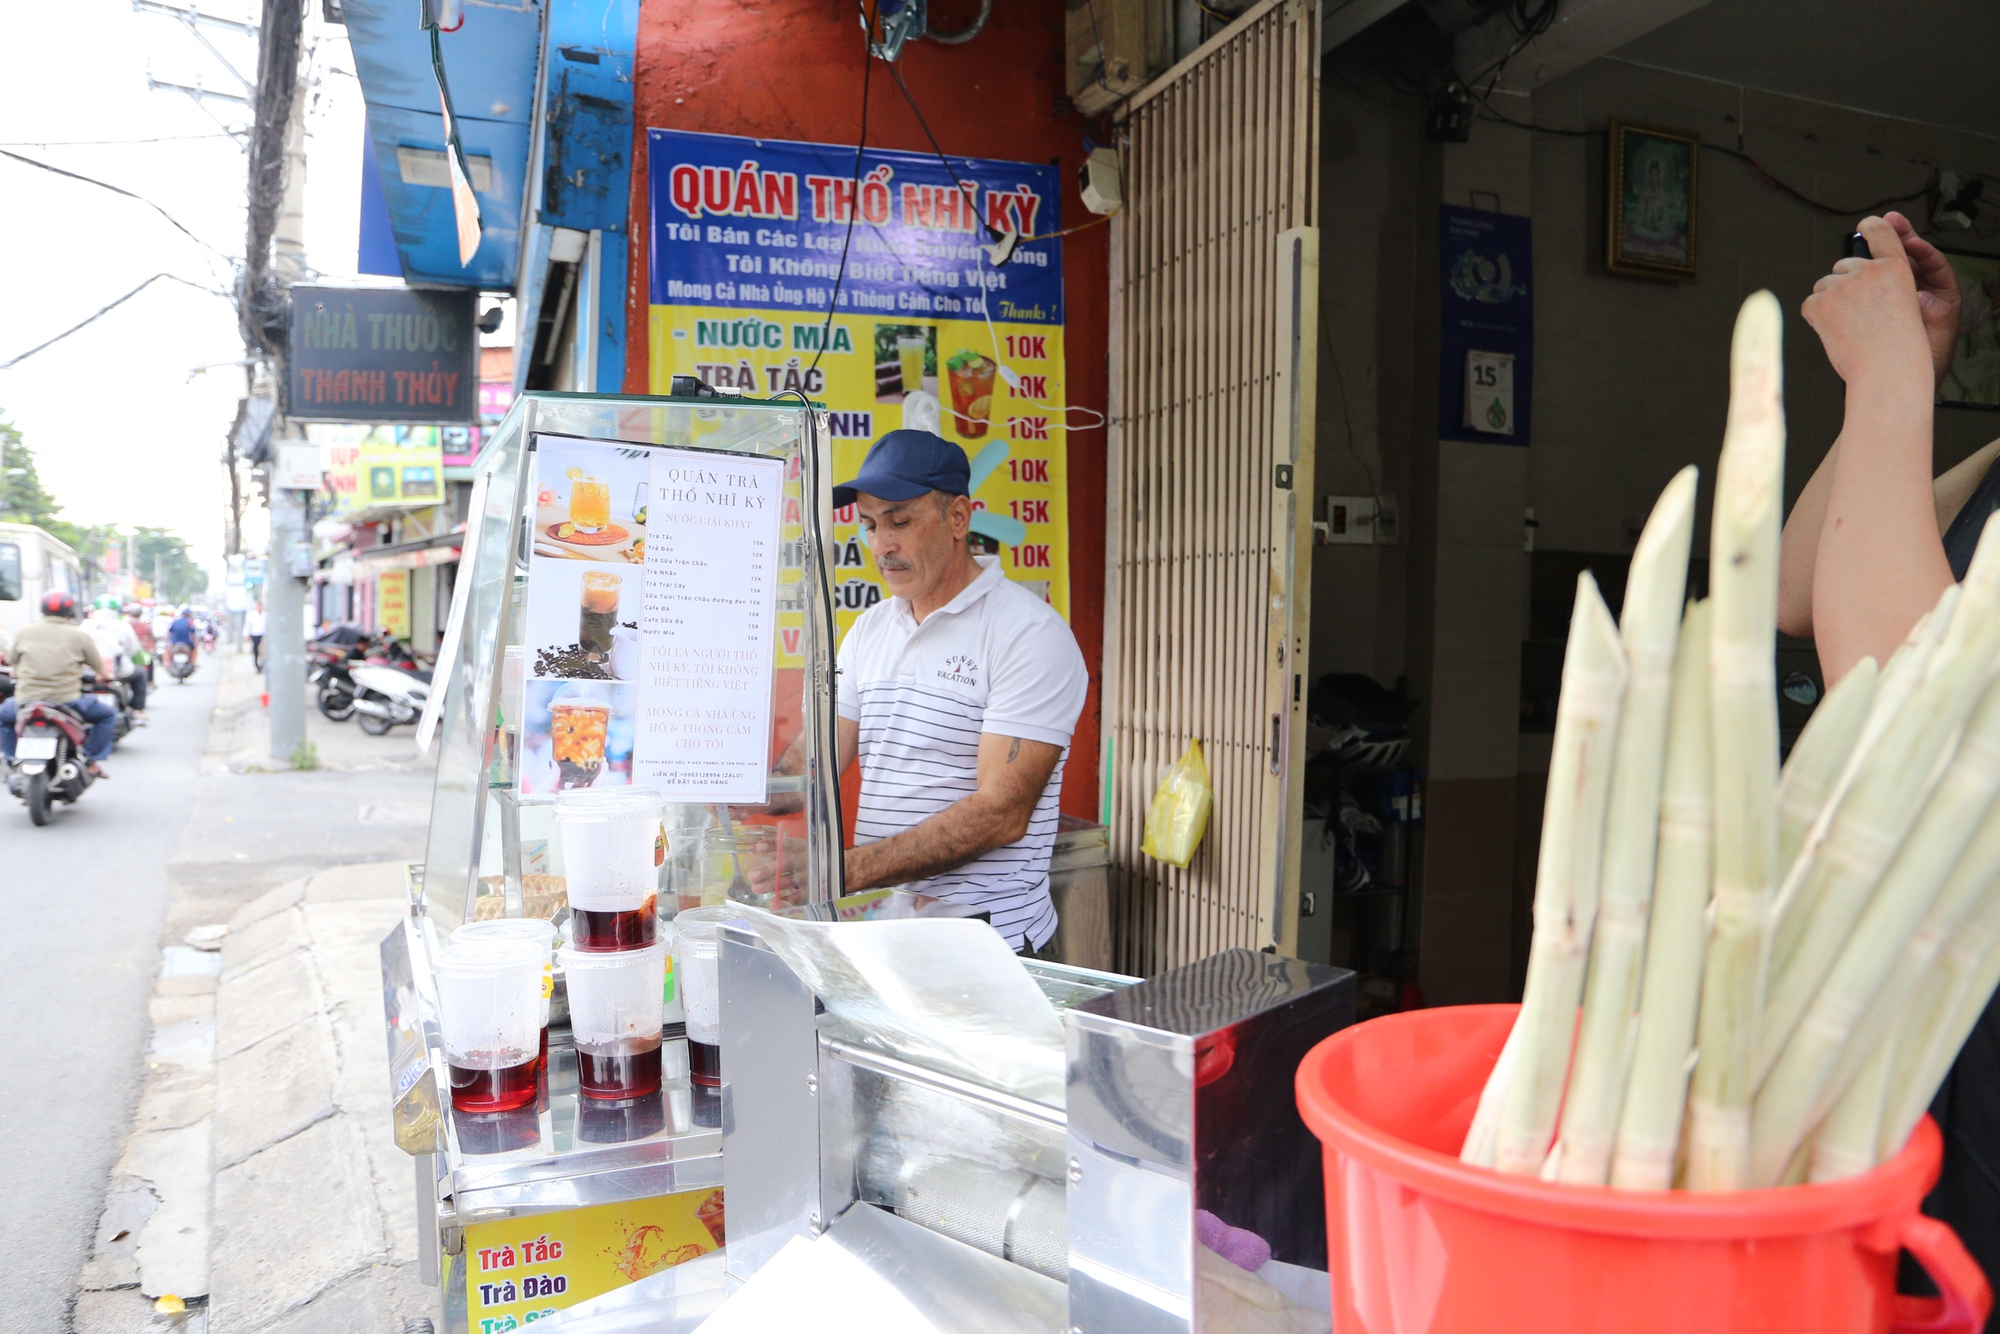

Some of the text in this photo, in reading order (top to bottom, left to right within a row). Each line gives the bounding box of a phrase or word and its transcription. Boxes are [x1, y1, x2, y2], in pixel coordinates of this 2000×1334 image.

[669, 161, 1041, 239] QUÁN THỔ NHĨ KỲ
[666, 222, 701, 242] Tôi
[706, 226, 750, 245] Bán
[756, 229, 798, 248] Các
[803, 233, 850, 254] Loại
[726, 254, 1007, 291] Tôi Không Biết Tiếng Việt
[667, 280, 713, 301] Mong
[715, 282, 737, 300] Cả
[739, 284, 770, 302] Nhà
[773, 281, 803, 306] Ủng
[806, 287, 826, 308] Hộ
[851, 290, 895, 311] Thông
[898, 291, 931, 312] Cảm
[934, 295, 962, 312] Cho
[965, 297, 986, 315] Tôi
[999, 300, 1047, 321] Thanks
[303, 302, 359, 350] NHÀ
[696, 317, 782, 349] NƯỚC
[792, 321, 852, 352] MÍA
[1005, 335, 1047, 360] 10K
[301, 368, 386, 405] THANH
[393, 361, 459, 406] THỦY
[696, 358, 824, 394] TRÀ TẮC
[1474, 365, 1496, 387] 15
[1006, 416, 1049, 441] 10K
[668, 468, 759, 489] QUÁN TRÀ
[1008, 458, 1050, 484] 10K
[660, 487, 766, 509] THỔ NHĨ KỲ
[666, 513, 697, 525] NƯỚC
[724, 518, 753, 530] KHÁT
[1008, 500, 1051, 524] 15K
[1009, 545, 1051, 569] 10K
[651, 646, 759, 661] TÔI LÀ NGƯỜI THỔ
[945, 655, 978, 671] SUNNY
[648, 661, 671, 672] NHĨ
[694, 663, 714, 674] TÔI
[717, 665, 759, 676] KHÔNG
[937, 670, 978, 687] VACATION
[654, 676, 749, 691] BIẾT TIẾNG VIỆT
[646, 707, 683, 718] MONG
[686, 707, 701, 719] CẢ
[704, 708, 729, 720] NHÀ
[649, 722, 752, 735] HỘ & THÔNG CẢM
[675, 738, 725, 749] CHO TÔI
[478, 1235, 562, 1270] Trà Tắc
[479, 1275, 566, 1305] Trà Đào
